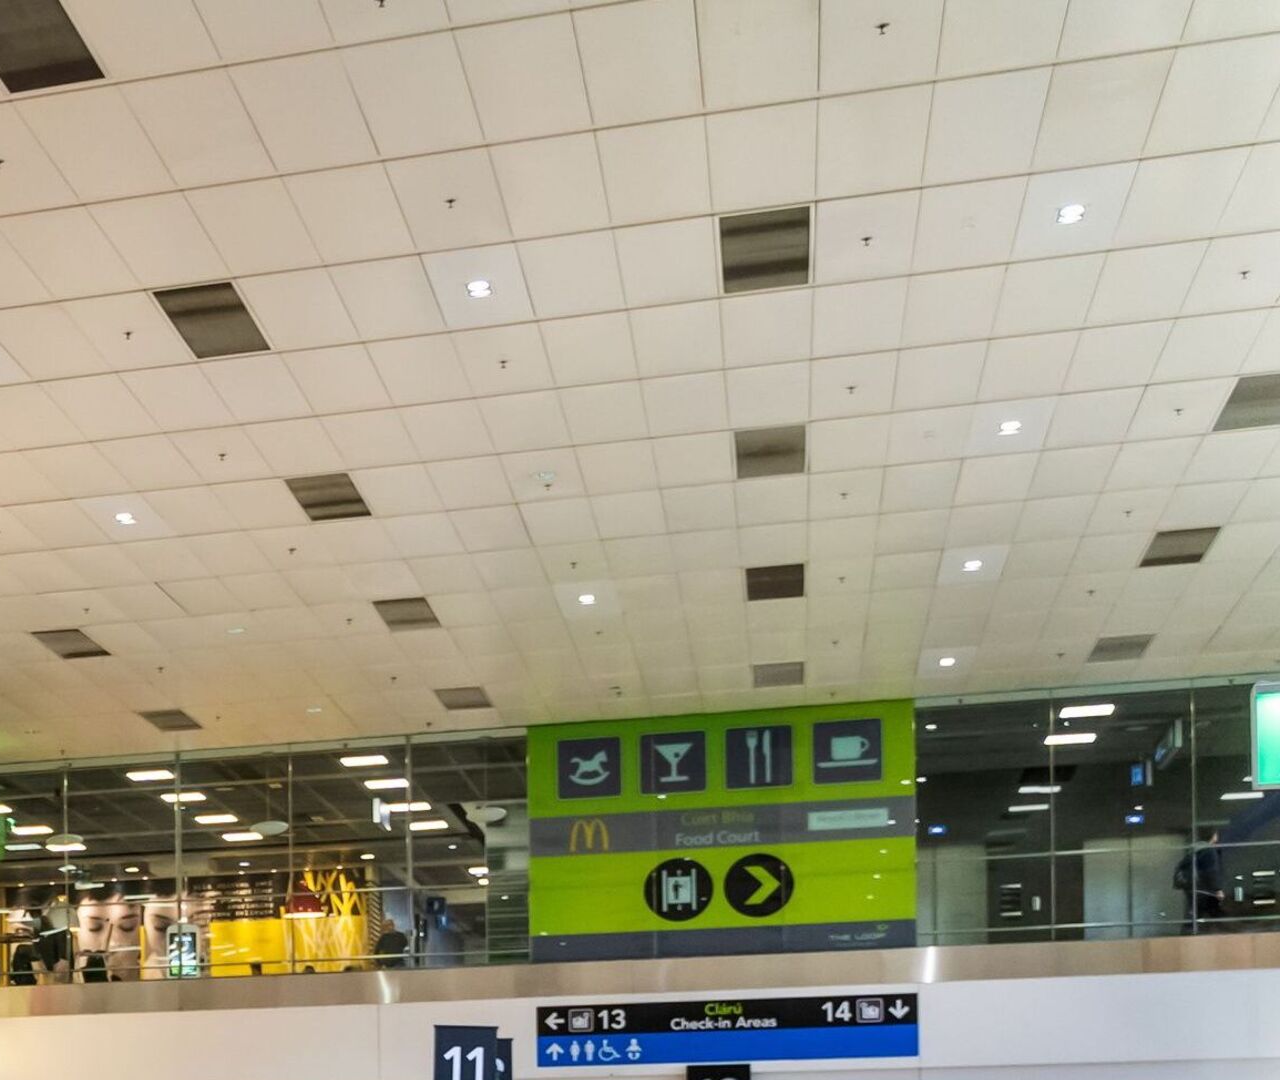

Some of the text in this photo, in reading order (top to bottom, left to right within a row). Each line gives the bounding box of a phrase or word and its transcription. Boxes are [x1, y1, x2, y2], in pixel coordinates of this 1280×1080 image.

[675, 830, 761, 846] Food Court
[597, 1010, 626, 1030] 13
[821, 1001, 852, 1022] 14
[670, 1015, 777, 1031] Check-in Areas
